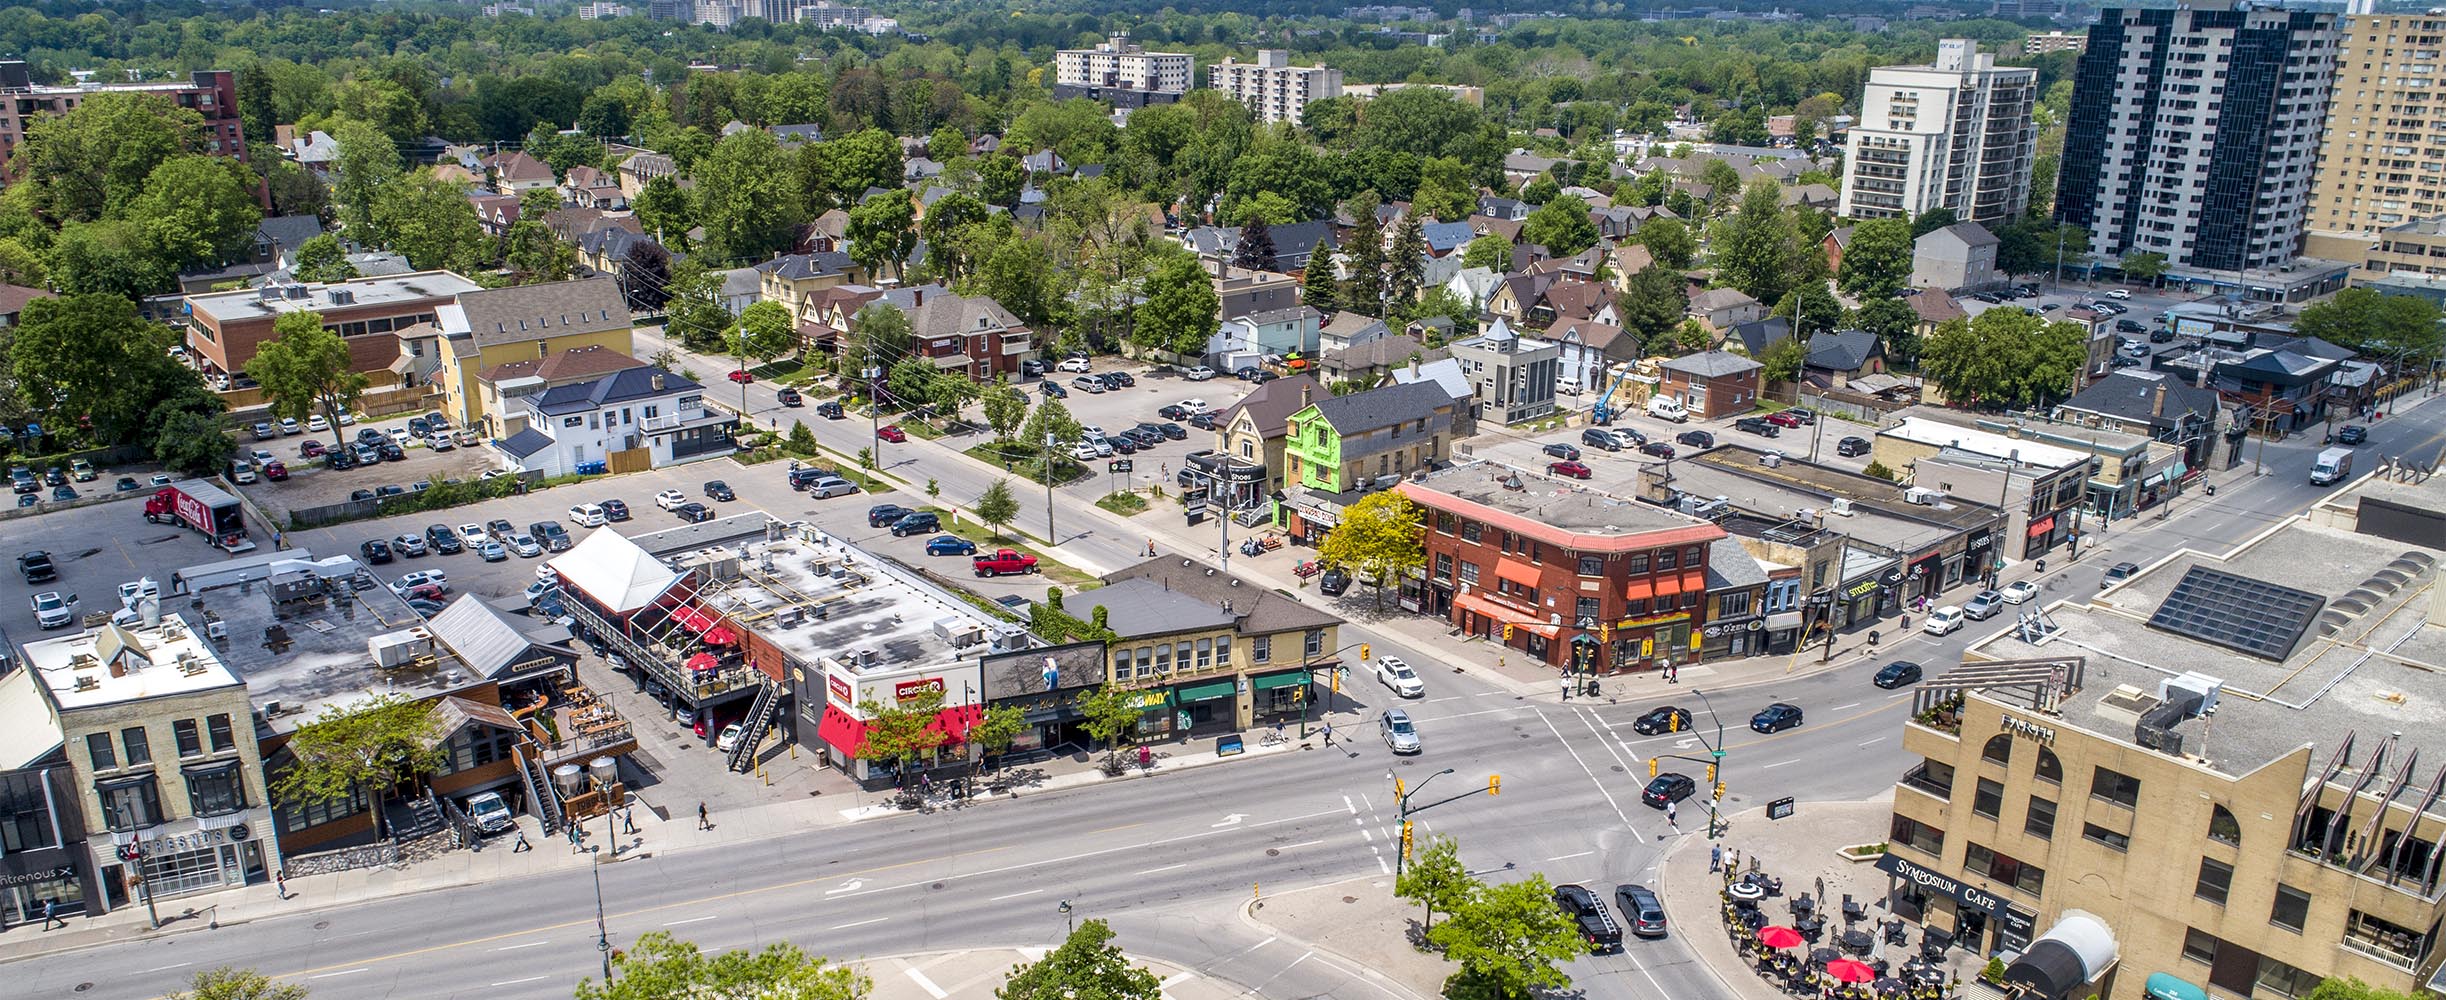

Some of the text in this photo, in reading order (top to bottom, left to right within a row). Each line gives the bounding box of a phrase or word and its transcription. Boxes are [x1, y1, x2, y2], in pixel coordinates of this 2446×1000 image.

[1231, 473, 1252, 482] Shoes
[2001, 713, 2055, 741] FARHI
[1896, 859, 1996, 911] SYMPOSIUM CAFE
